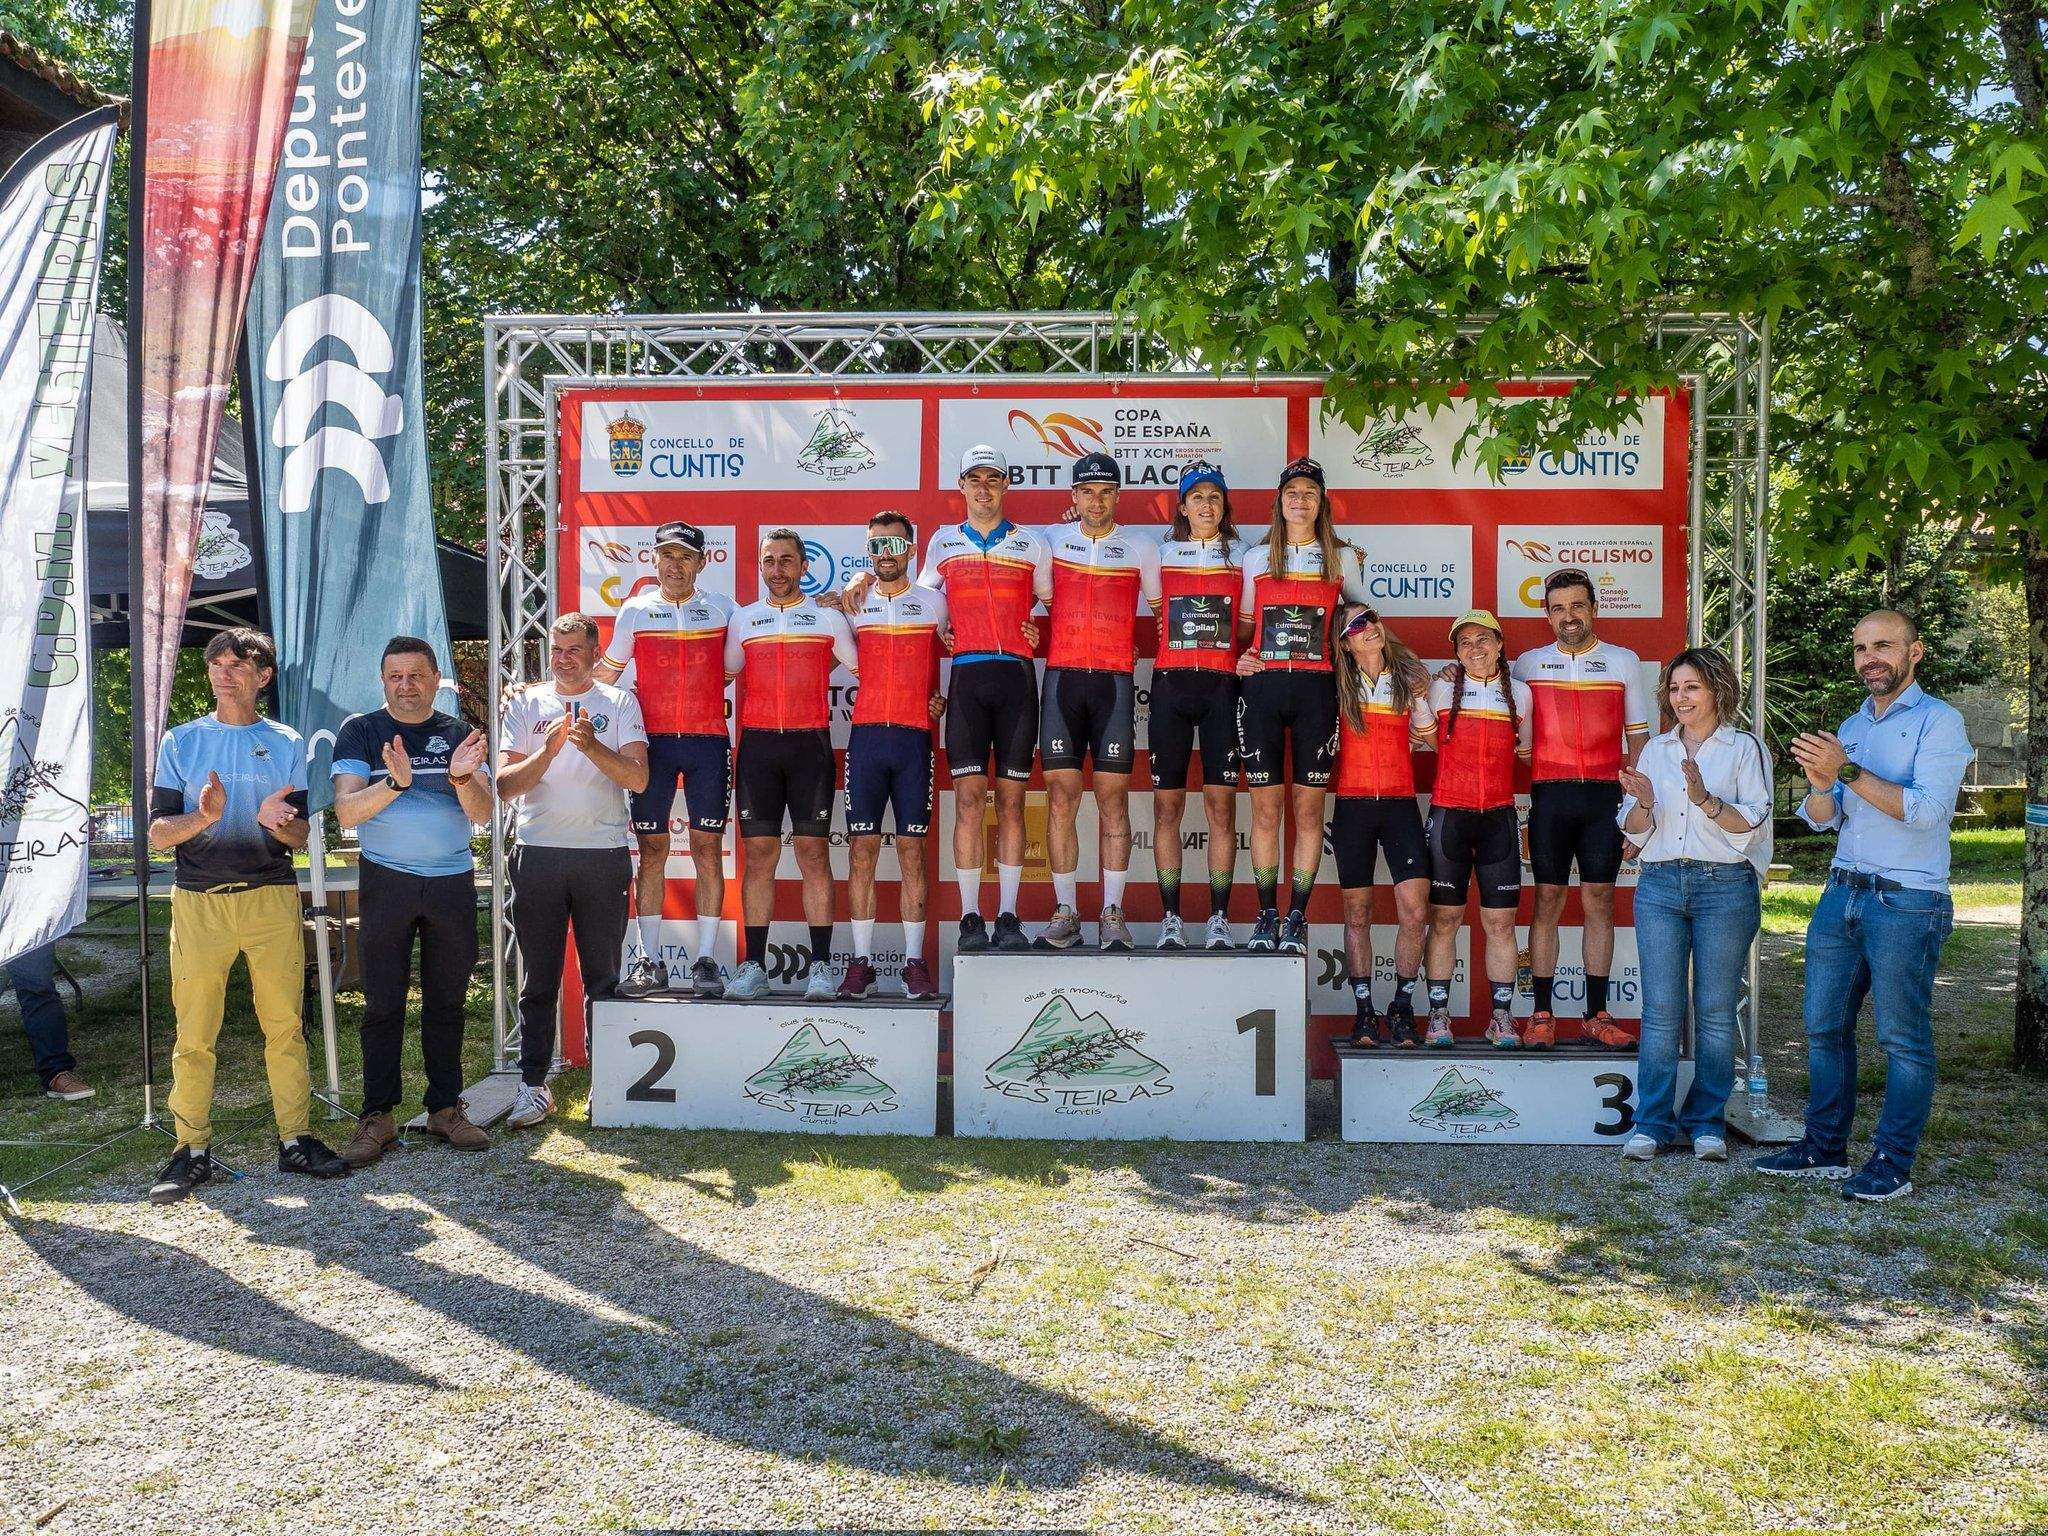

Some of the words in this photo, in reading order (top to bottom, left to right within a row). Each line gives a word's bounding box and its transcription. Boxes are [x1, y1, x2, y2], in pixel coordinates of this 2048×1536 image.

[31, 160, 102, 481] XESTEIRAS
[1114, 409, 1161, 421] COPA
[1114, 426, 1136, 437] DE
[1143, 423, 1211, 437] ESPAÑA
[650, 439, 713, 449] CONCELLO
[730, 438, 745, 448] DE
[1624, 435, 1640, 445] DE
[1114, 448, 1140, 459] BTT
[1144, 448, 1173, 459] XCM
[650, 454, 744, 478] CUNTIS
[797, 457, 877, 476] XESTEIRAS
[1352, 453, 1435, 472] XESTEIRAS
[1539, 451, 1640, 476] CUNTIS
[1009, 465, 1061, 485] BTT
[194, 552, 248, 572] STEIRAS
[1557, 549, 1653, 563] CICLISMO
[1370, 563, 1428, 573] CONCELLO
[1441, 563, 1456, 573] DE
[1369, 577, 1455, 599] CUNTIS
[1600, 595, 1630, 603] Superior
[1275, 622, 1312, 630] Extremadura
[410, 756, 448, 766] TEIRAS
[636, 821, 657, 830] KZJ
[700, 817, 724, 828] KZJ
[850, 822, 874, 831] KZJ
[907, 824, 928, 833] KZJ
[0, 820, 89, 863] TEIRAS
[627, 944, 689, 960] XNTA
[1624, 967, 1638, 976] DE
[1069, 987, 1128, 1005] montaña
[1552, 980, 1638, 1002] CUTIS
[818, 1017, 866, 1035] montaña
[1236, 1009, 1276, 1097] 1
[626, 1030, 677, 1102] 2
[983, 1074, 1175, 1106] XESTEIRAS
[742, 1085, 899, 1118] XESTEIRAS
[1593, 1073, 1636, 1136] 3
[799, 1115, 838, 1124] Cuntis
[1054, 1106, 1102, 1116] Cuntis
[1408, 1113, 1521, 1134] XESTEIRAS
